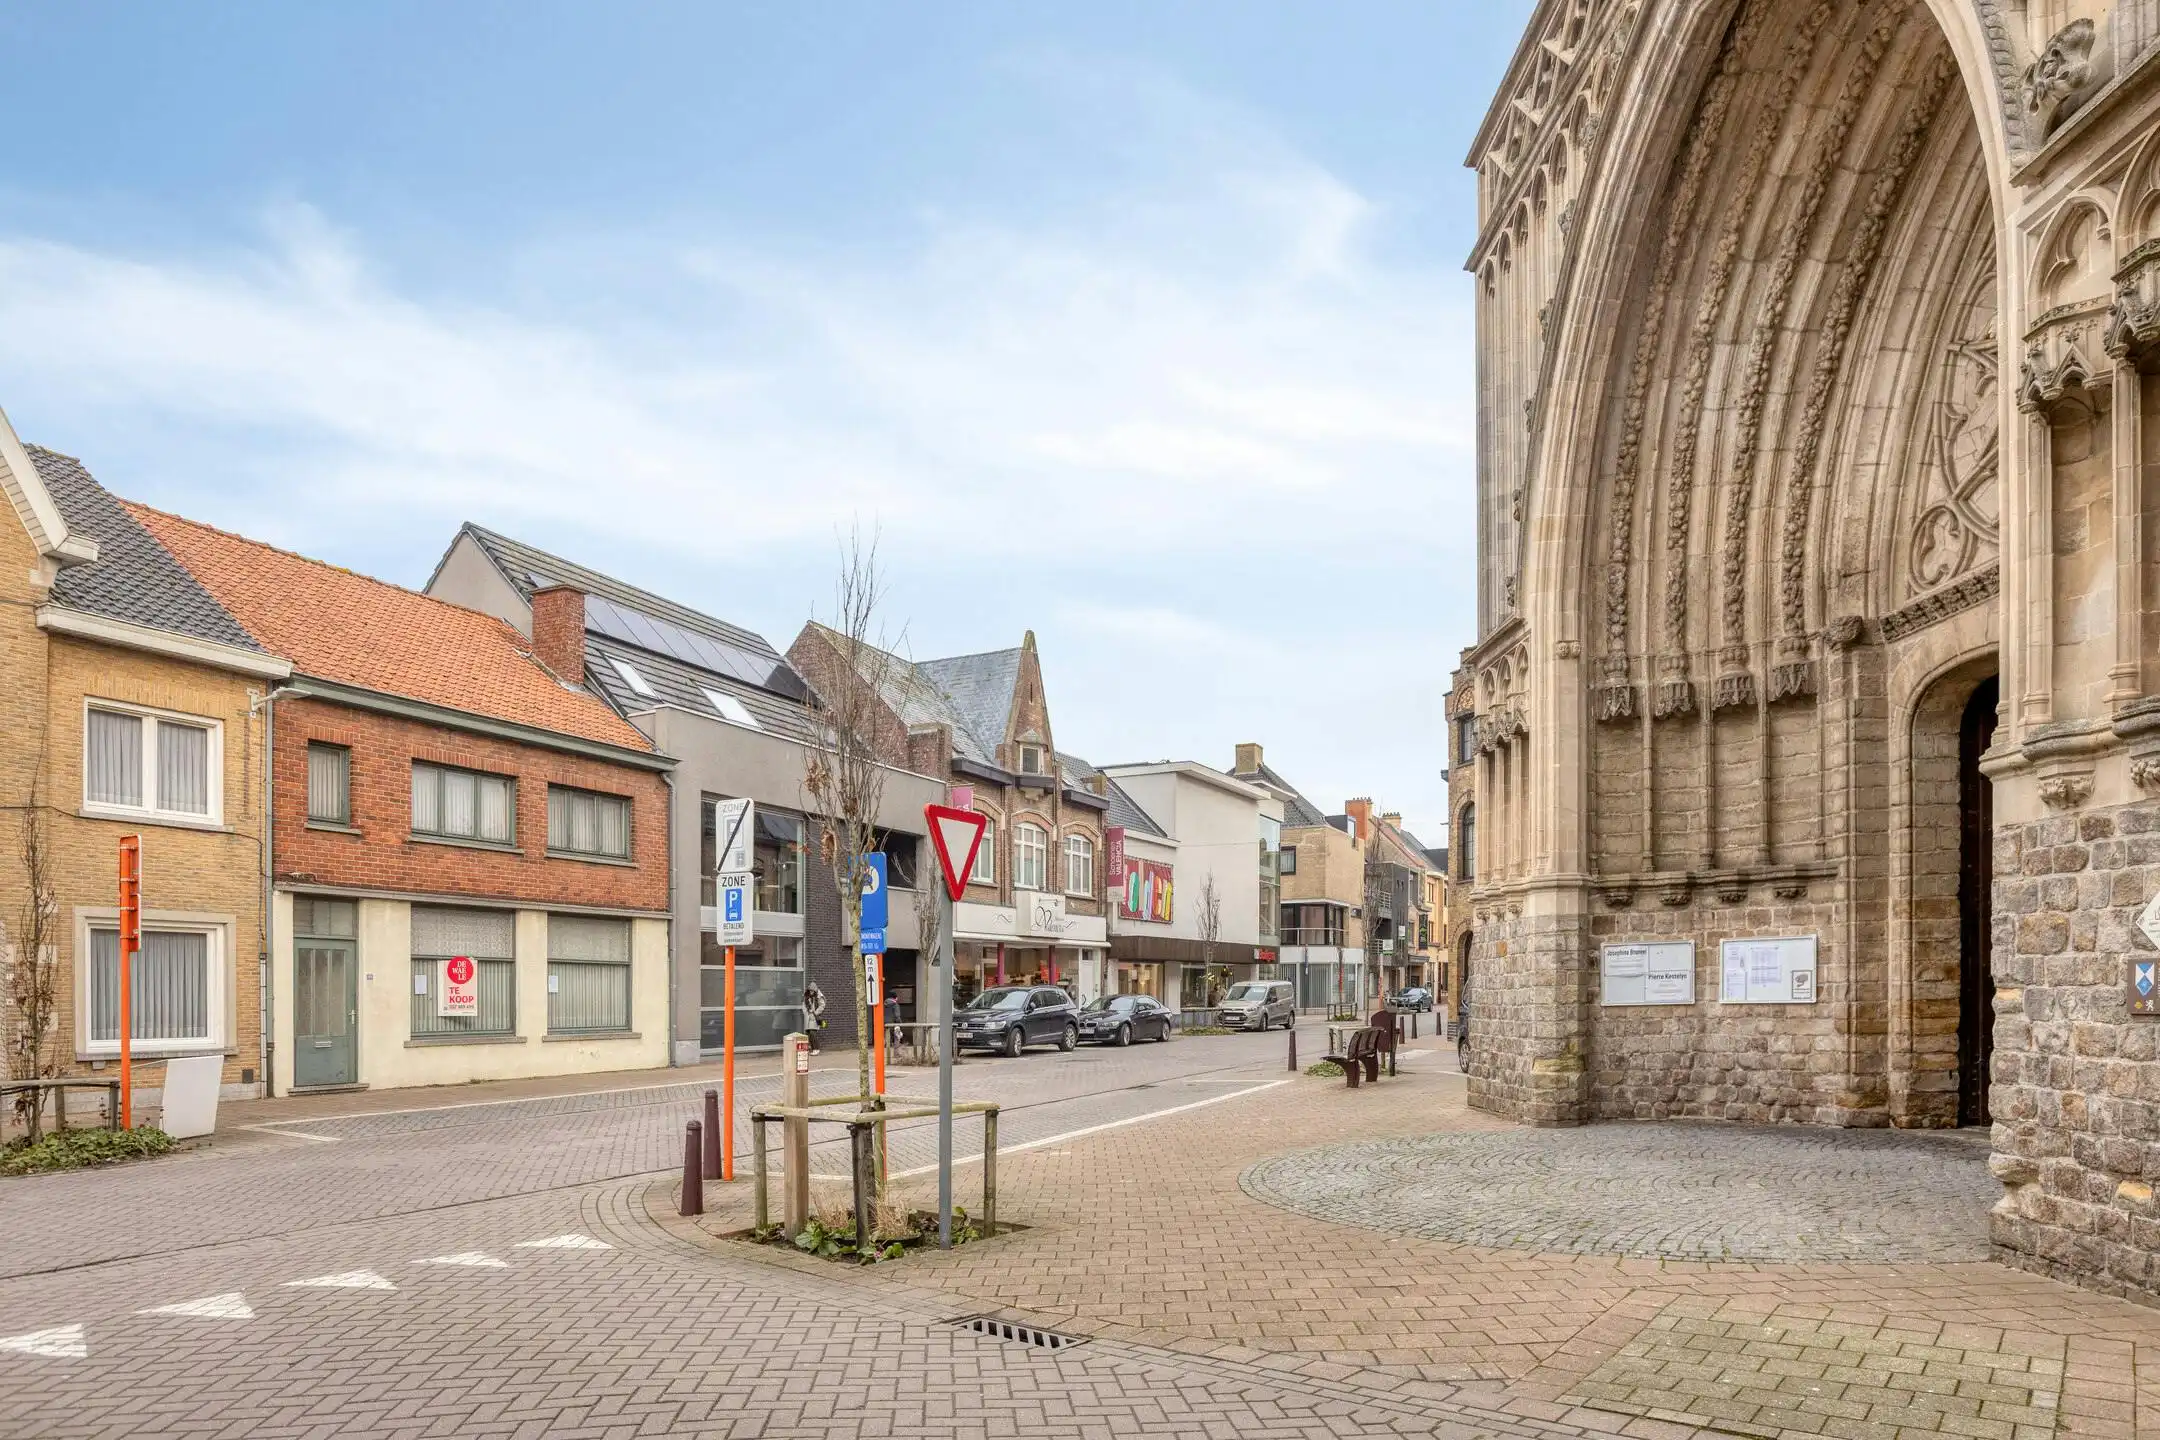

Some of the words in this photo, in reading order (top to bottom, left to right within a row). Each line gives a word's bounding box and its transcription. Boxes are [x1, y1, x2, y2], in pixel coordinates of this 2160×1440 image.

[722, 876, 745, 887] ZONE
[729, 890, 738, 909] P
[867, 957, 873, 965] 12
[448, 986, 460, 994] TE
